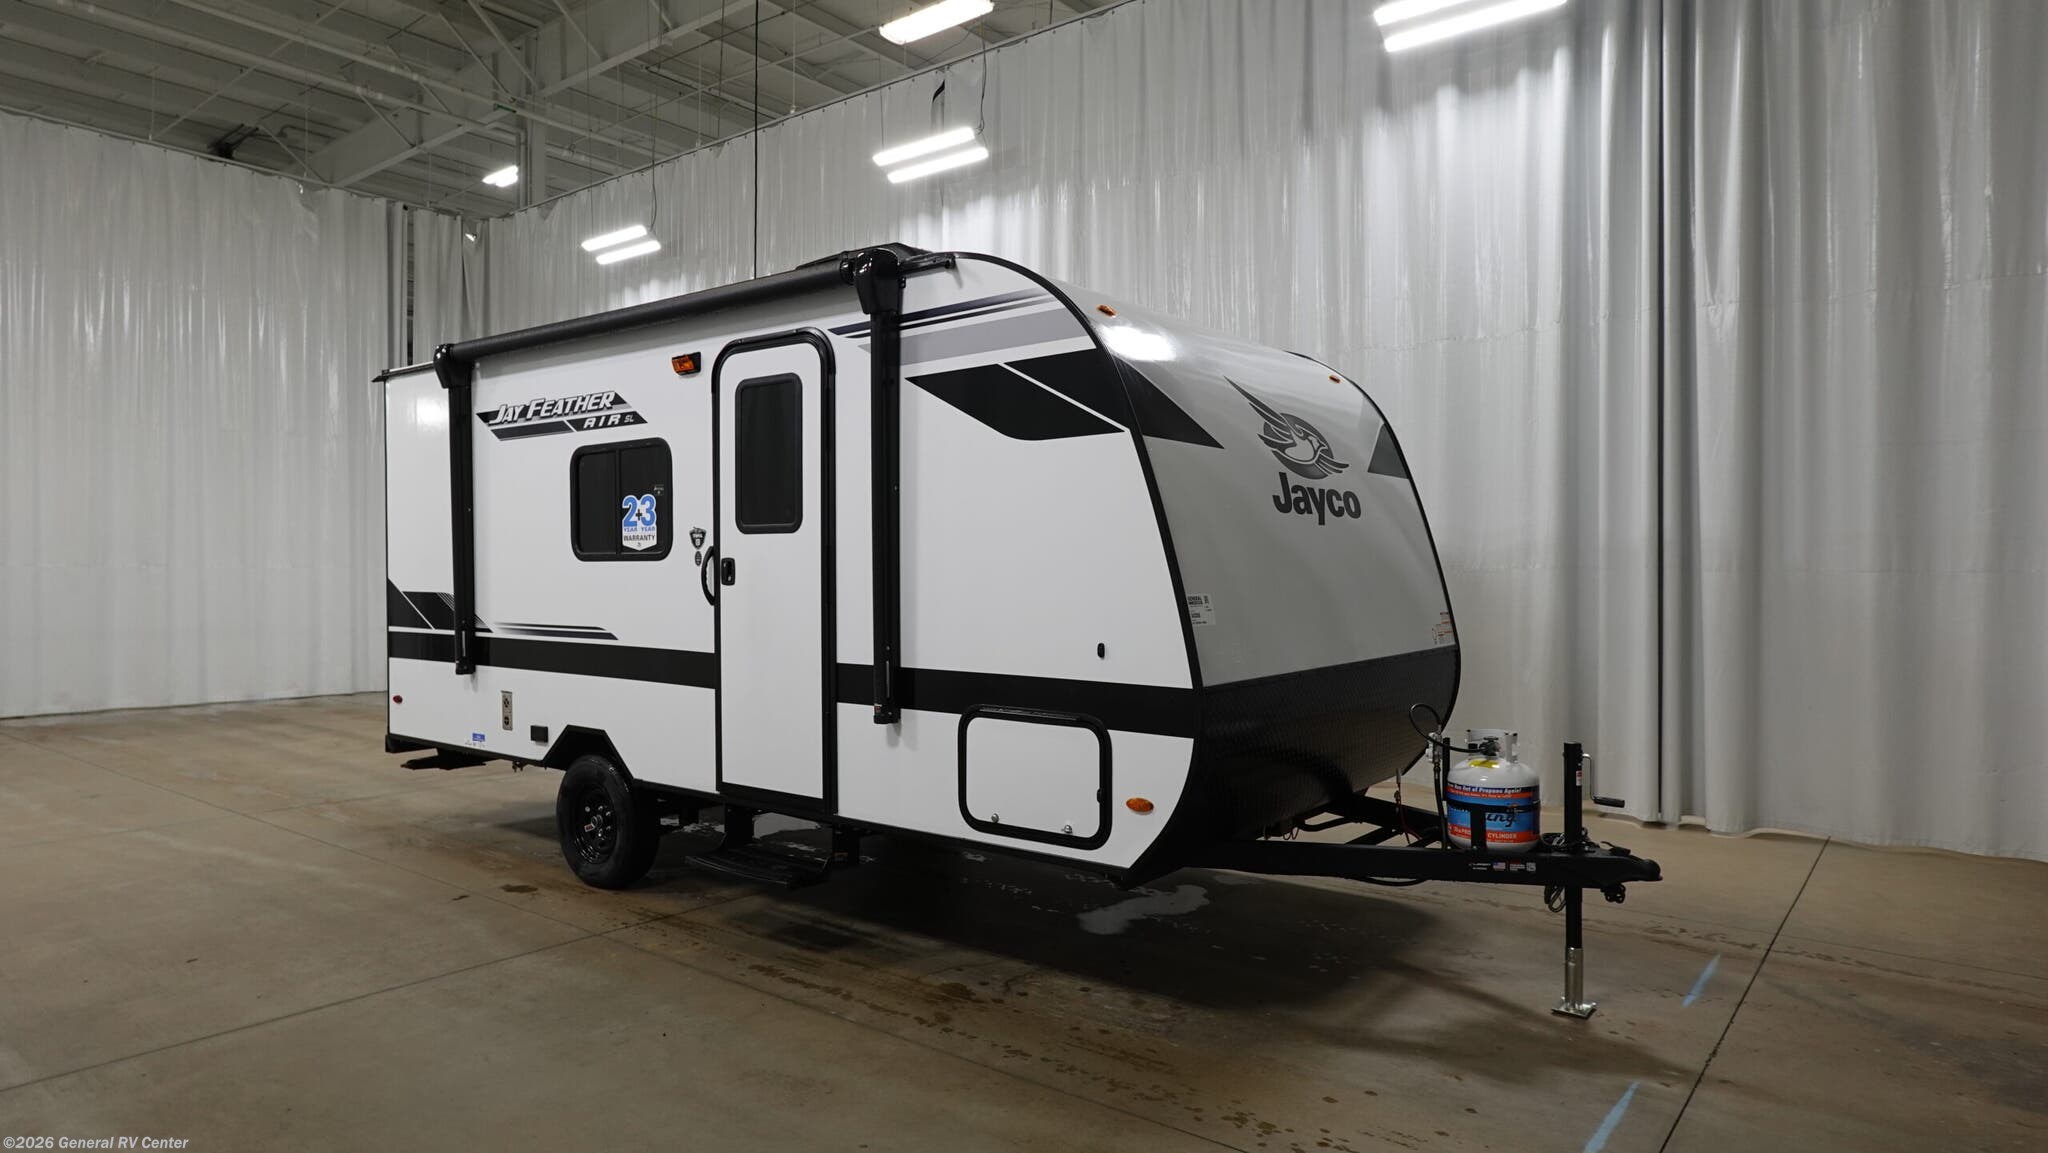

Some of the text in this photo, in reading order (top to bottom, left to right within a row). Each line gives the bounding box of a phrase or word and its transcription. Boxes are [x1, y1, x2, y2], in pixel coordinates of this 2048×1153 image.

[489, 390, 616, 425] JAY FEATHER
[583, 414, 622, 429] AIR
[1272, 472, 1361, 525] Jayco
[624, 534, 655, 542] WARRANTY
[1486, 813, 1514, 827] ing
